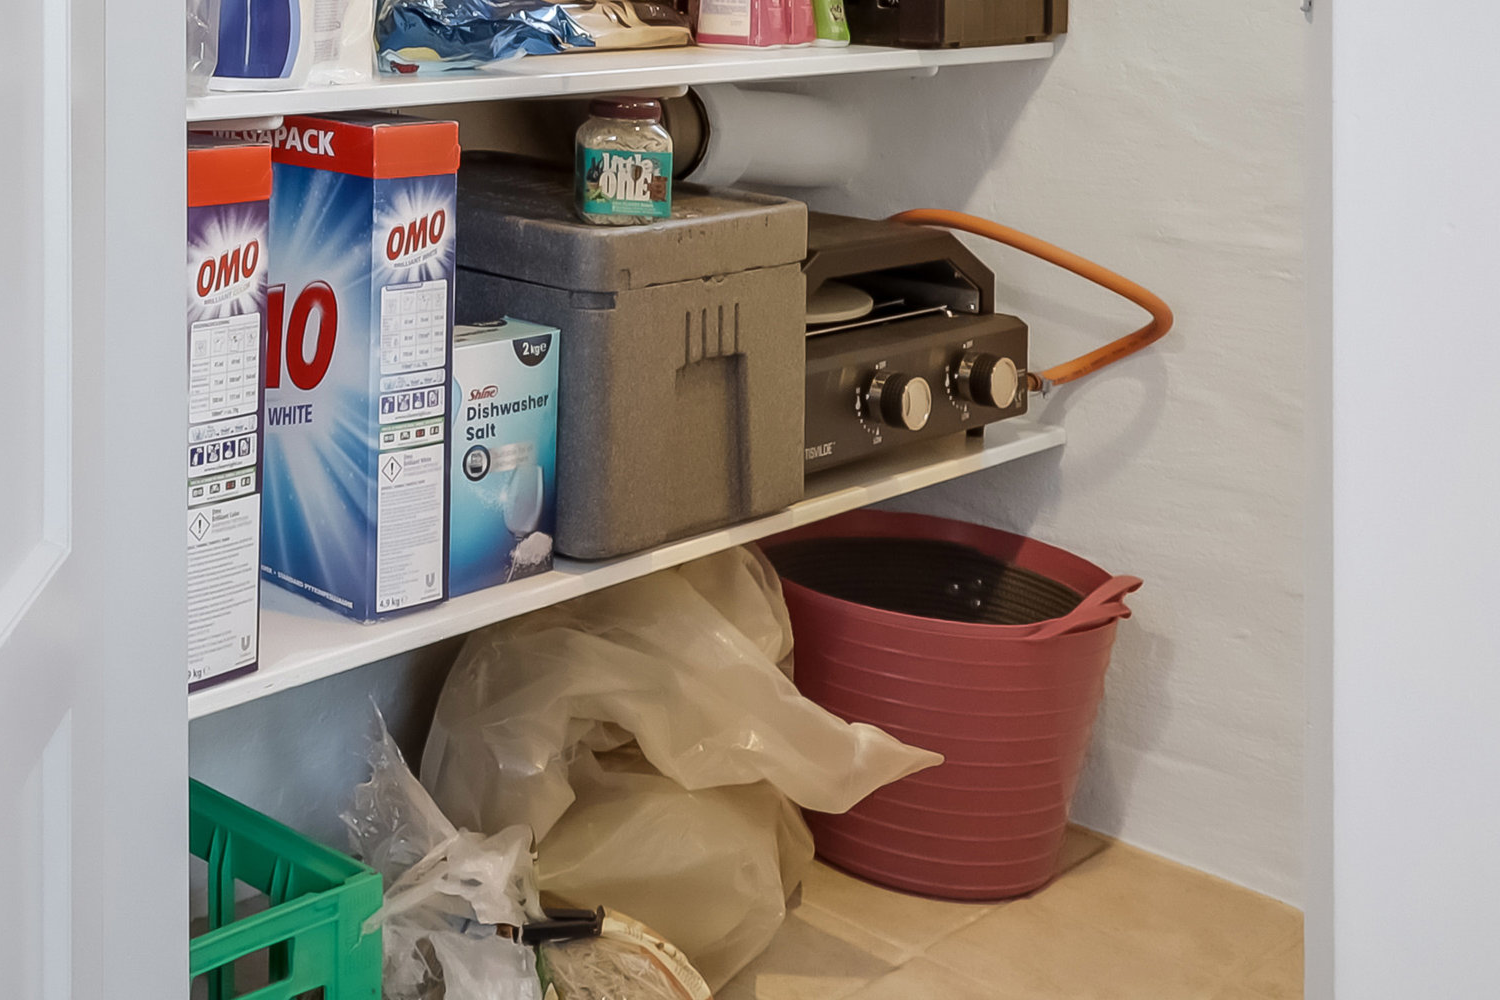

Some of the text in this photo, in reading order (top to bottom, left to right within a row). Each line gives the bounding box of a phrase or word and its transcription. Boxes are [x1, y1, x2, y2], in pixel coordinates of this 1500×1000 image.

[385, 208, 446, 262] OMO
[196, 239, 259, 298] OMO
[468, 385, 499, 402] Shine
[268, 404, 313, 426] WHITE
[466, 394, 549, 421] Dishwasher
[466, 423, 496, 441] Salt
